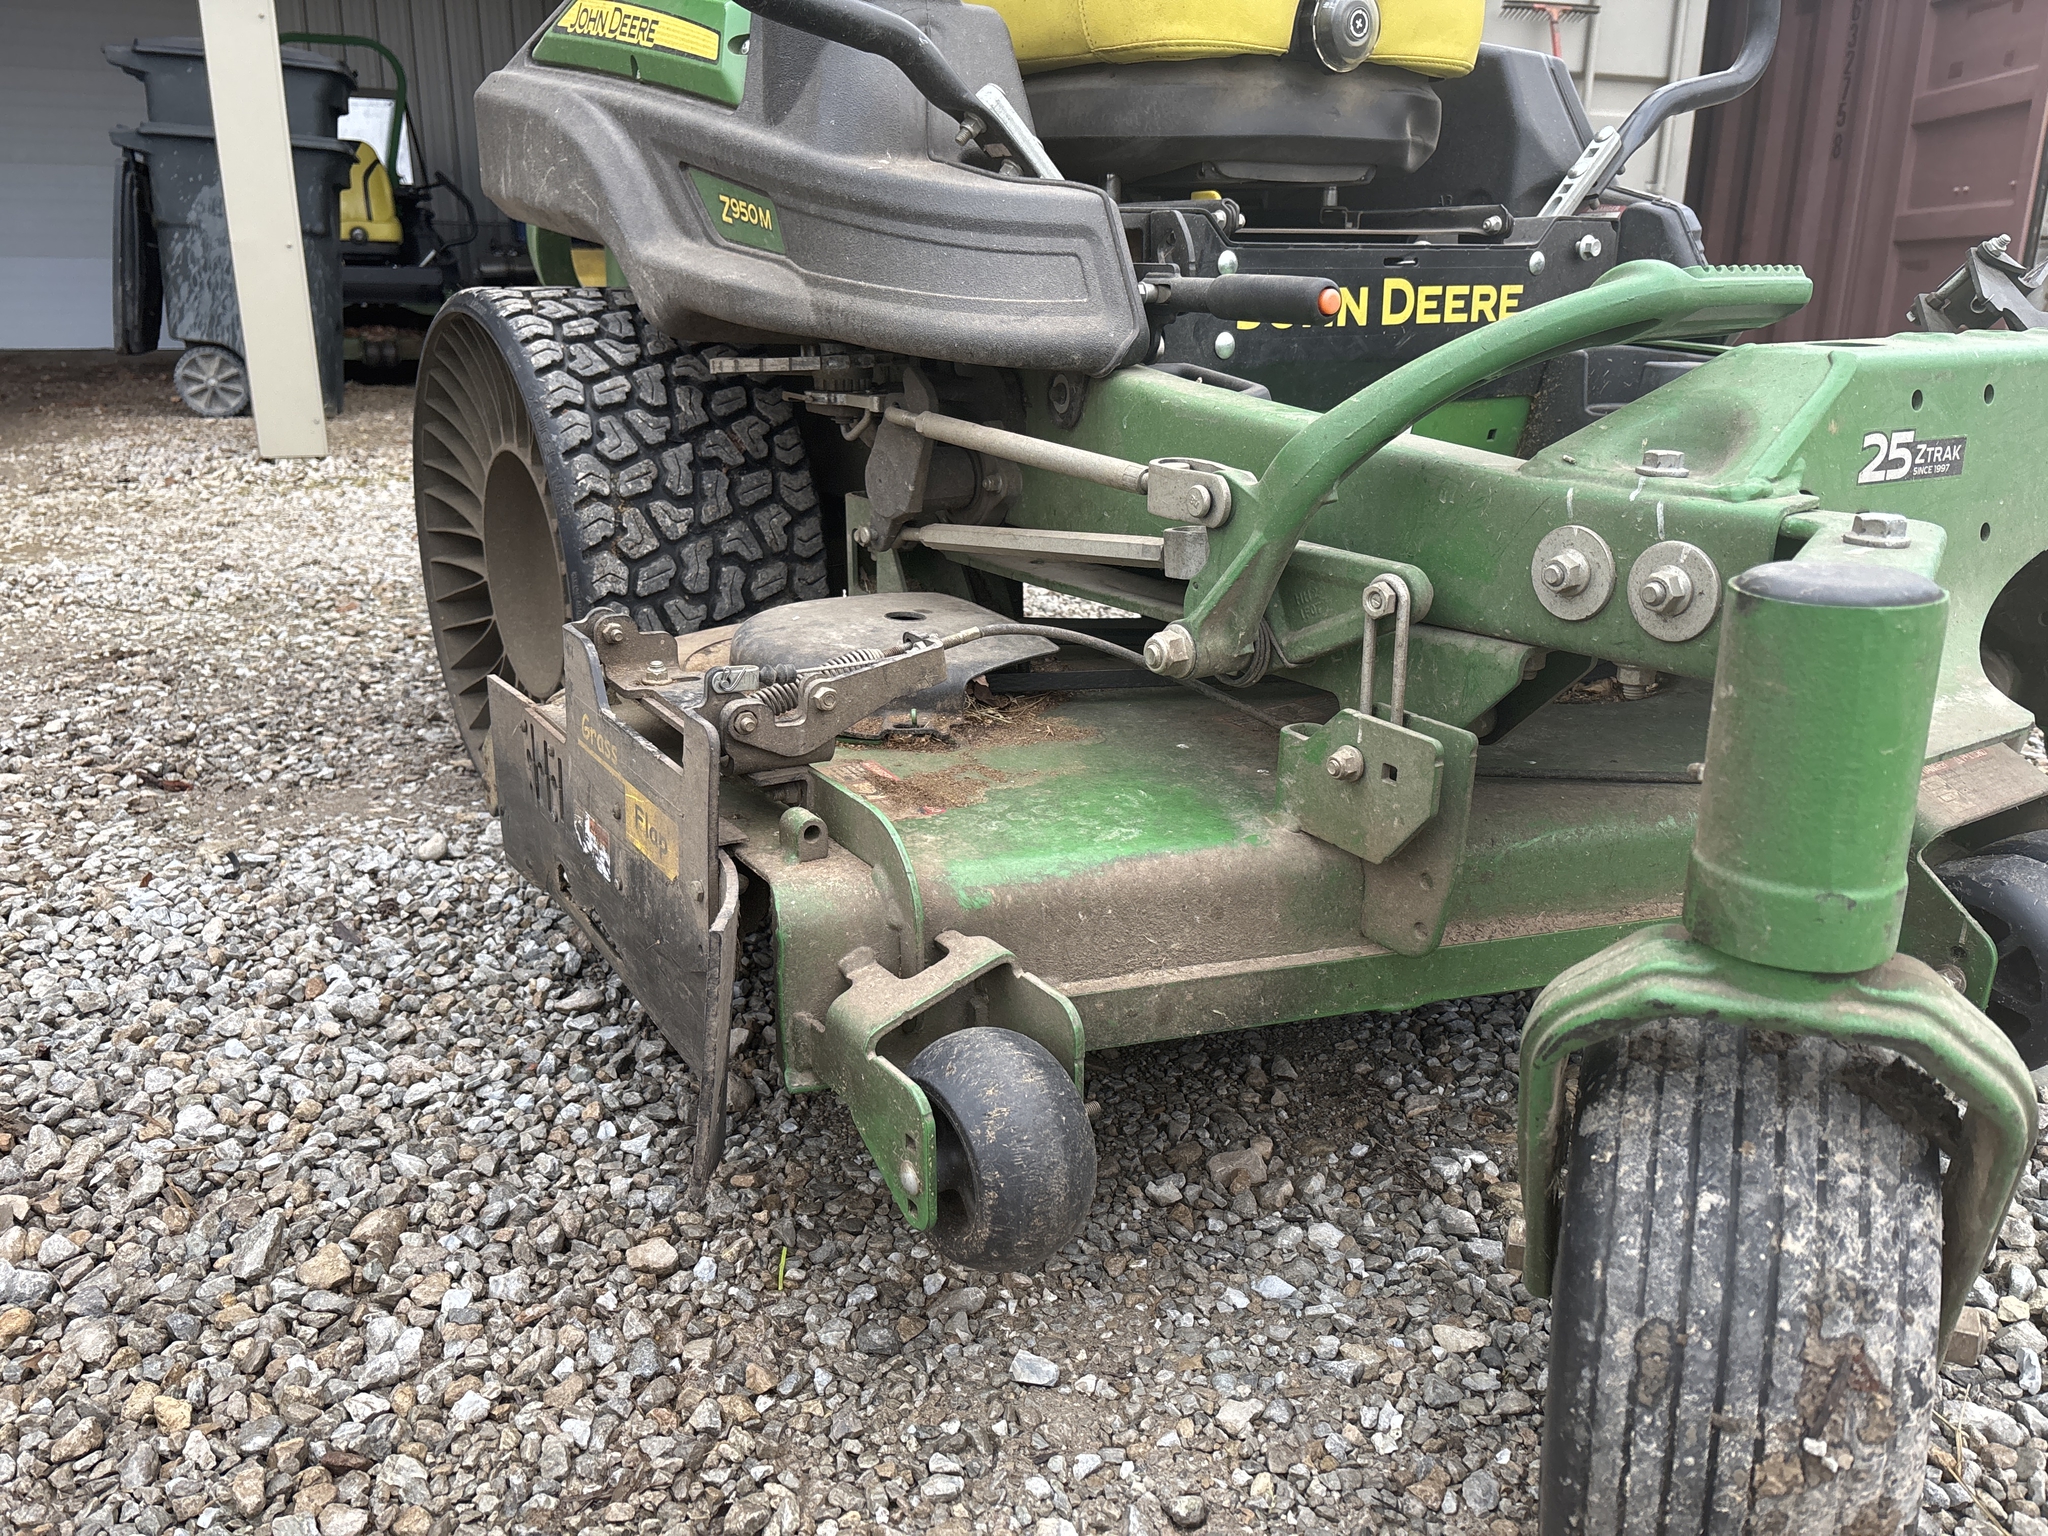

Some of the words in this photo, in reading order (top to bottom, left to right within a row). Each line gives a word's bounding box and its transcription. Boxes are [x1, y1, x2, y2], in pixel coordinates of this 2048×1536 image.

[569, 3, 609, 33] JOHN
[608, 7, 660, 43] DEERE
[719, 194, 773, 231] Z950M
[1382, 277, 1524, 325] DEERE
[1857, 430, 1915, 484] 25
[1914, 443, 1963, 465] ZTRAK
[1912, 465, 1933, 476] SINCE
[1934, 463, 1950, 474] 1997
[581, 713, 618, 766] Grass
[634, 803, 668, 860] Flap
